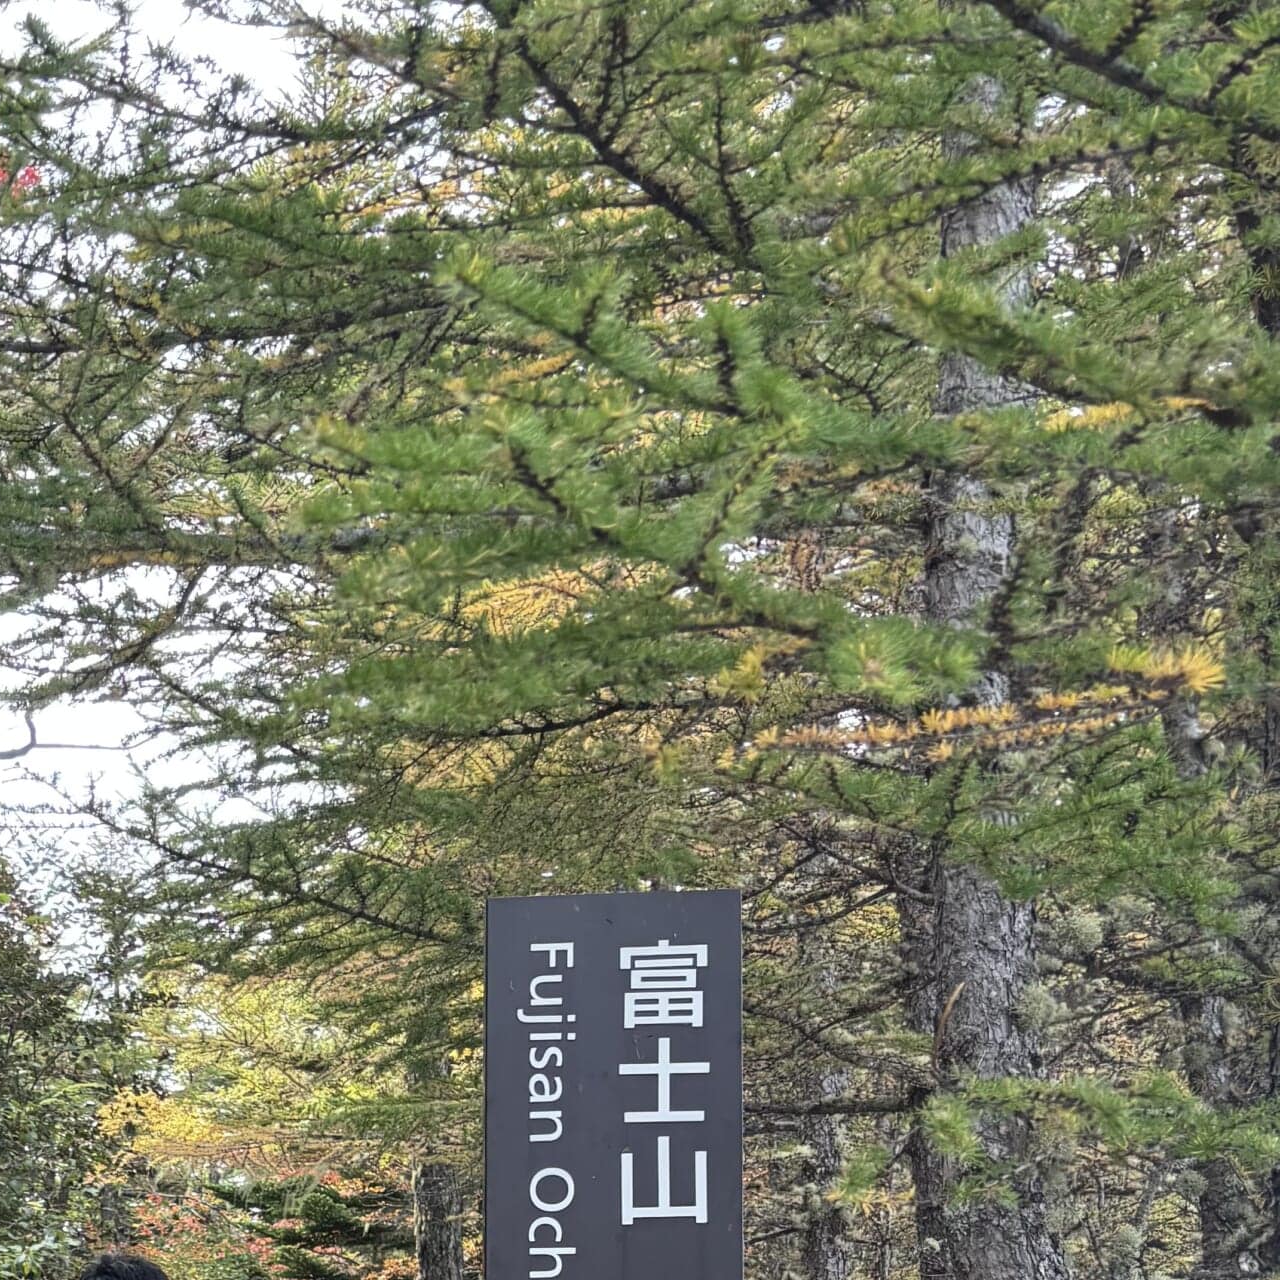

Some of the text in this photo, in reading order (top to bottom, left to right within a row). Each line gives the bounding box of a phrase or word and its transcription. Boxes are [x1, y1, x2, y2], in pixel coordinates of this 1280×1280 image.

[516, 941, 577, 1142] Fujisan
[618, 938, 711, 1226] 富士山
